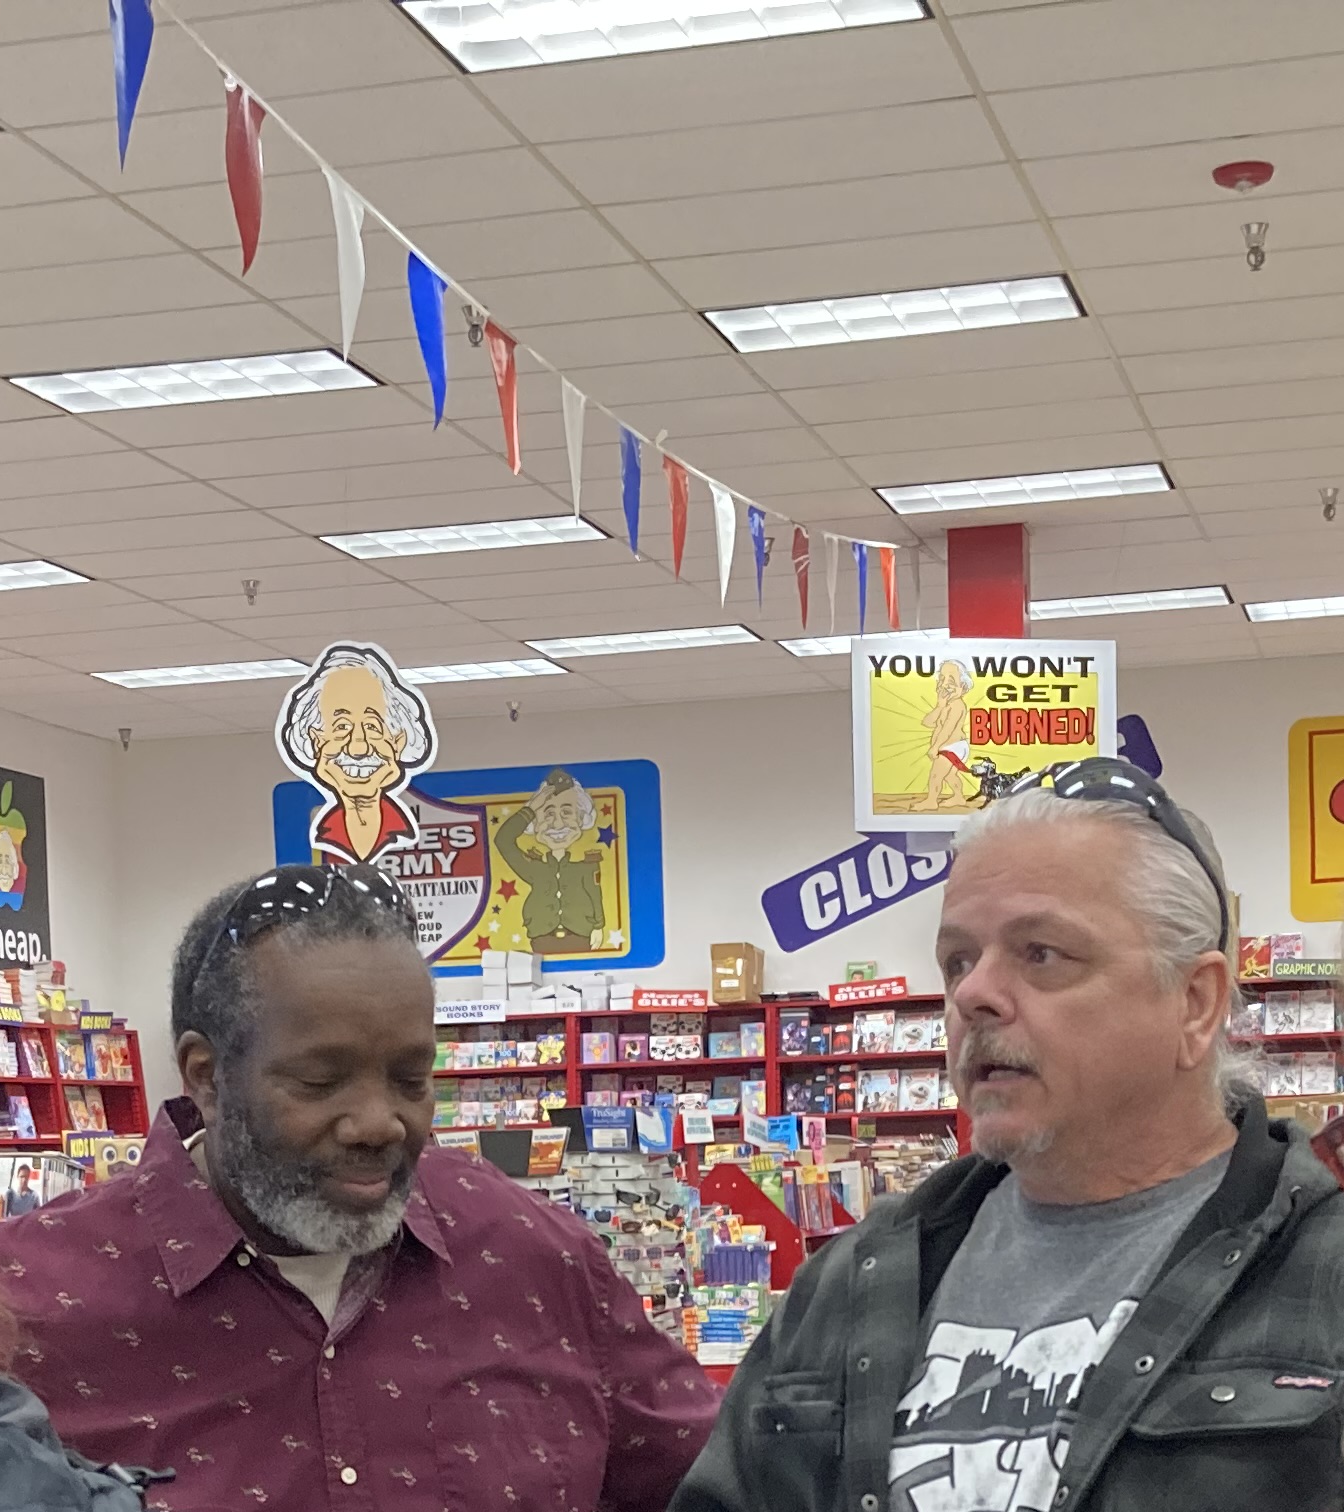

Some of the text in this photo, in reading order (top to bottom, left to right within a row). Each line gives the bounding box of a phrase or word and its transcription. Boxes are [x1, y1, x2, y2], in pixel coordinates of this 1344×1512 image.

[868, 655, 1095, 678] YOU WON'T
[986, 684, 1078, 703] GET
[970, 707, 1095, 745] BURNED!
[1275, 962, 1315, 976] GRAPHIC
[834, 985, 905, 1002] OLLIE'S
[471, 1004, 501, 1012] STORY
[637, 998, 705, 1007] OLLIE'S
[446, 1011, 484, 1019] BOOKS
